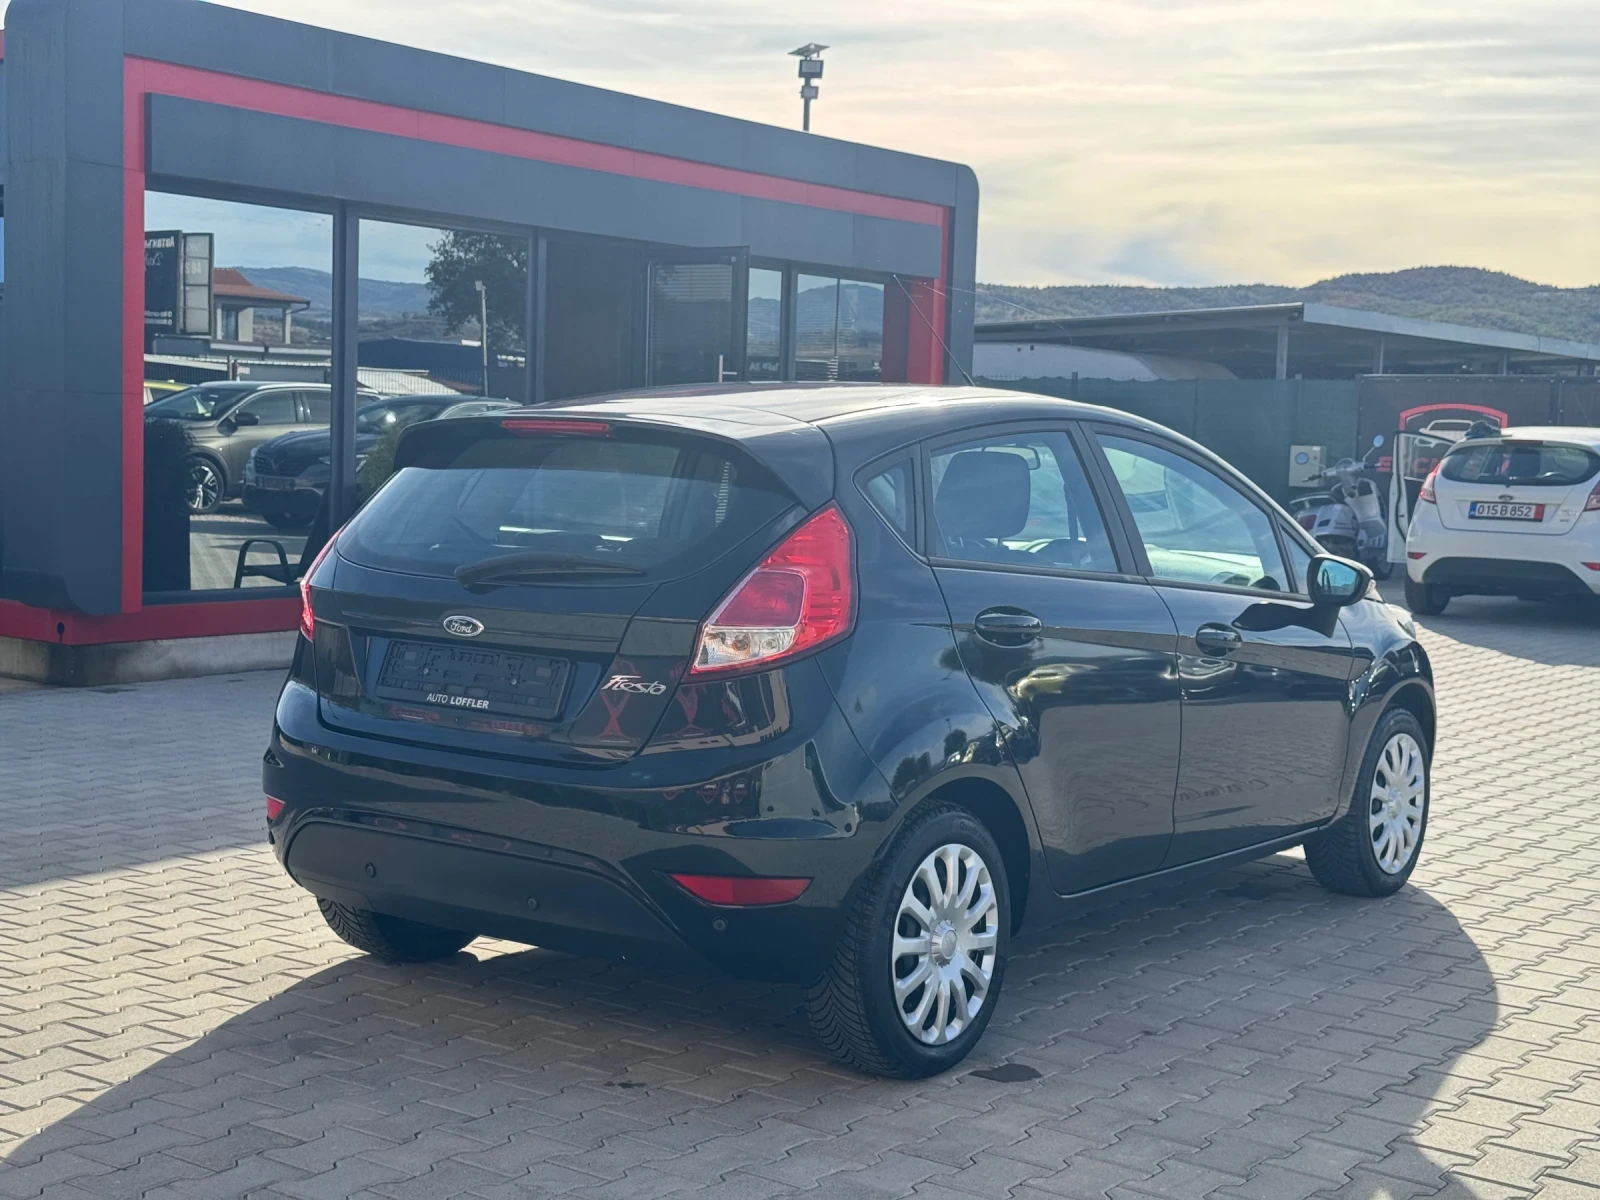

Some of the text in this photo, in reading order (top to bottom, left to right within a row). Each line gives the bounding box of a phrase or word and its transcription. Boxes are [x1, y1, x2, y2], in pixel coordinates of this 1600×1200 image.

[450, 619, 473, 633] Ford
[601, 675, 667, 695] Fiesta
[426, 692, 448, 704] AUTO
